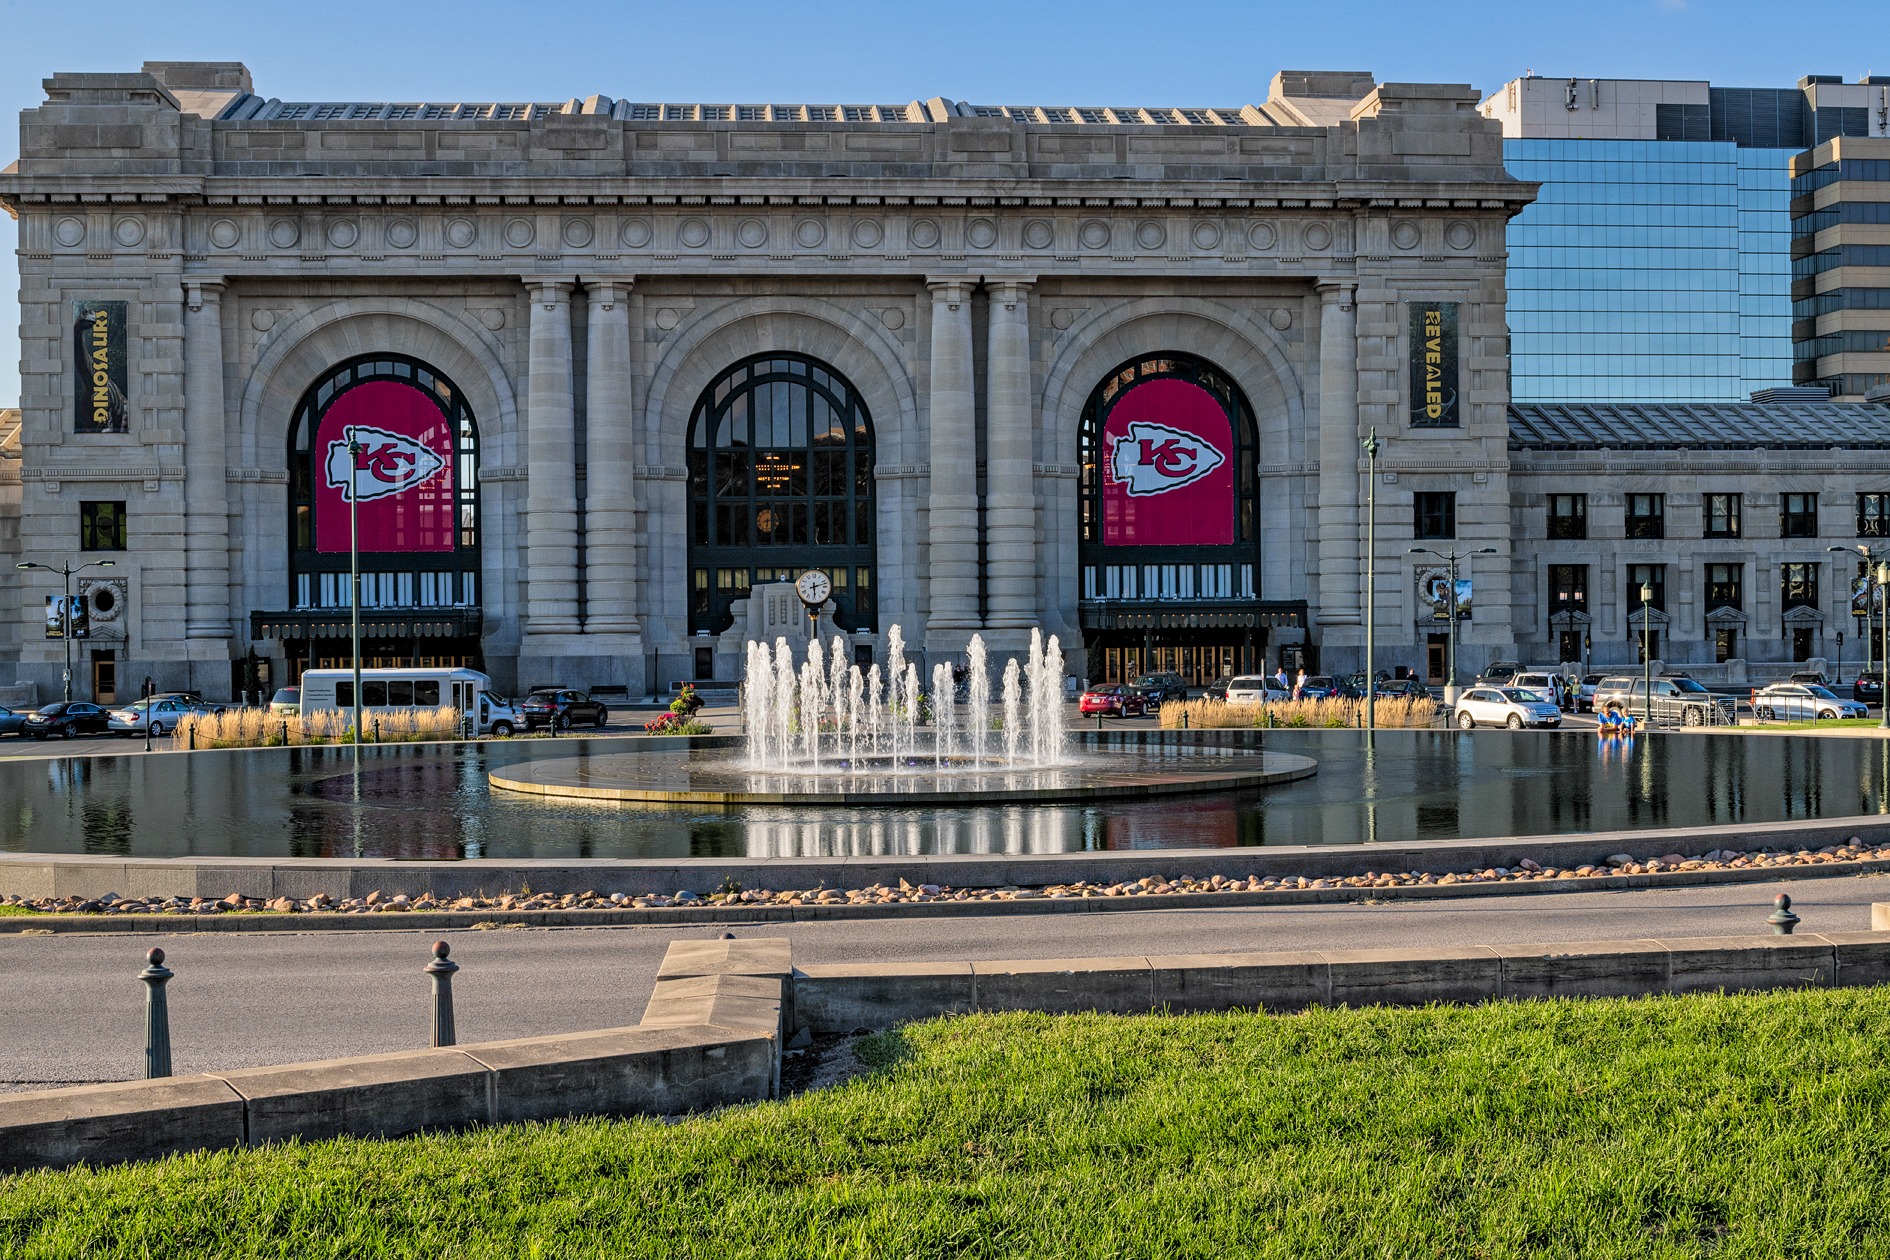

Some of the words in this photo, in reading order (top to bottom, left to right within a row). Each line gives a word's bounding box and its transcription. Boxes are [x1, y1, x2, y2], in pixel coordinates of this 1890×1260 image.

[93, 310, 109, 424] DINOSAURS
[1425, 311, 1442, 418] REVEALED
[355, 443, 416, 484] KC
[1138, 439, 1198, 478] KC
